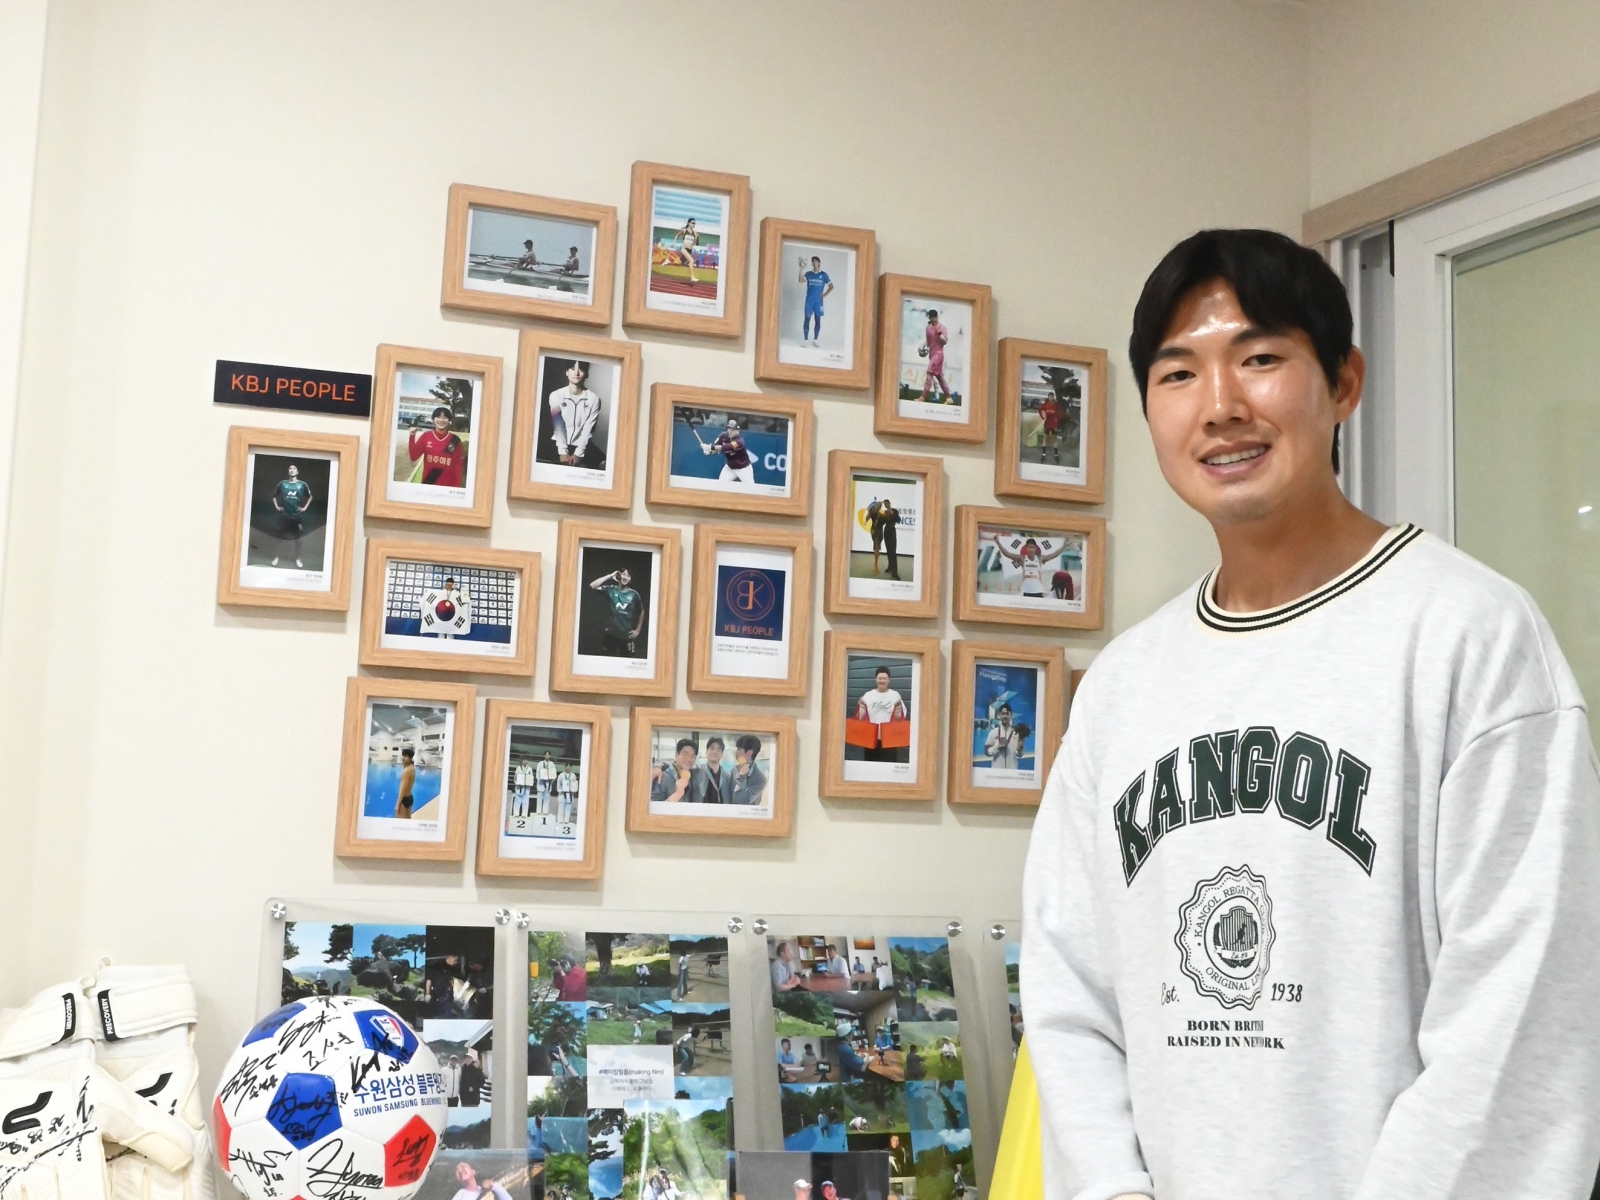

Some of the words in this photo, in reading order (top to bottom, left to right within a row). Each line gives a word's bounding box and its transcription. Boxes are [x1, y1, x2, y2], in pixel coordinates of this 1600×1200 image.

[231, 373, 269, 394] KBJ
[276, 378, 356, 402] PEOPLE
[724, 624, 740, 634] KBJ
[742, 625, 774, 636] PEOPLE
[1113, 725, 1377, 888] KANGOL
[516, 820, 526, 829] 2
[541, 817, 547, 826] 1
[562, 826, 571, 835] 3
[1195, 896, 1222, 938] KANGOL
[1223, 885, 1259, 906] REGATTA
[1205, 967, 1250, 990] ORIGINAL
[1161, 982, 1180, 1005] Est.
[1270, 982, 1303, 1003] 1938
[101, 998, 114, 1035] PRECOVERY
[1187, 1020, 1231, 1031] BORN
[1167, 1036, 1222, 1047] RAISED
[1225, 1036, 1240, 1047] IN
[354, 1075, 416, 1104] 수원삼성
[354, 1105, 383, 1117] SUWON
[384, 1098, 418, 1112] SAMSUNG
